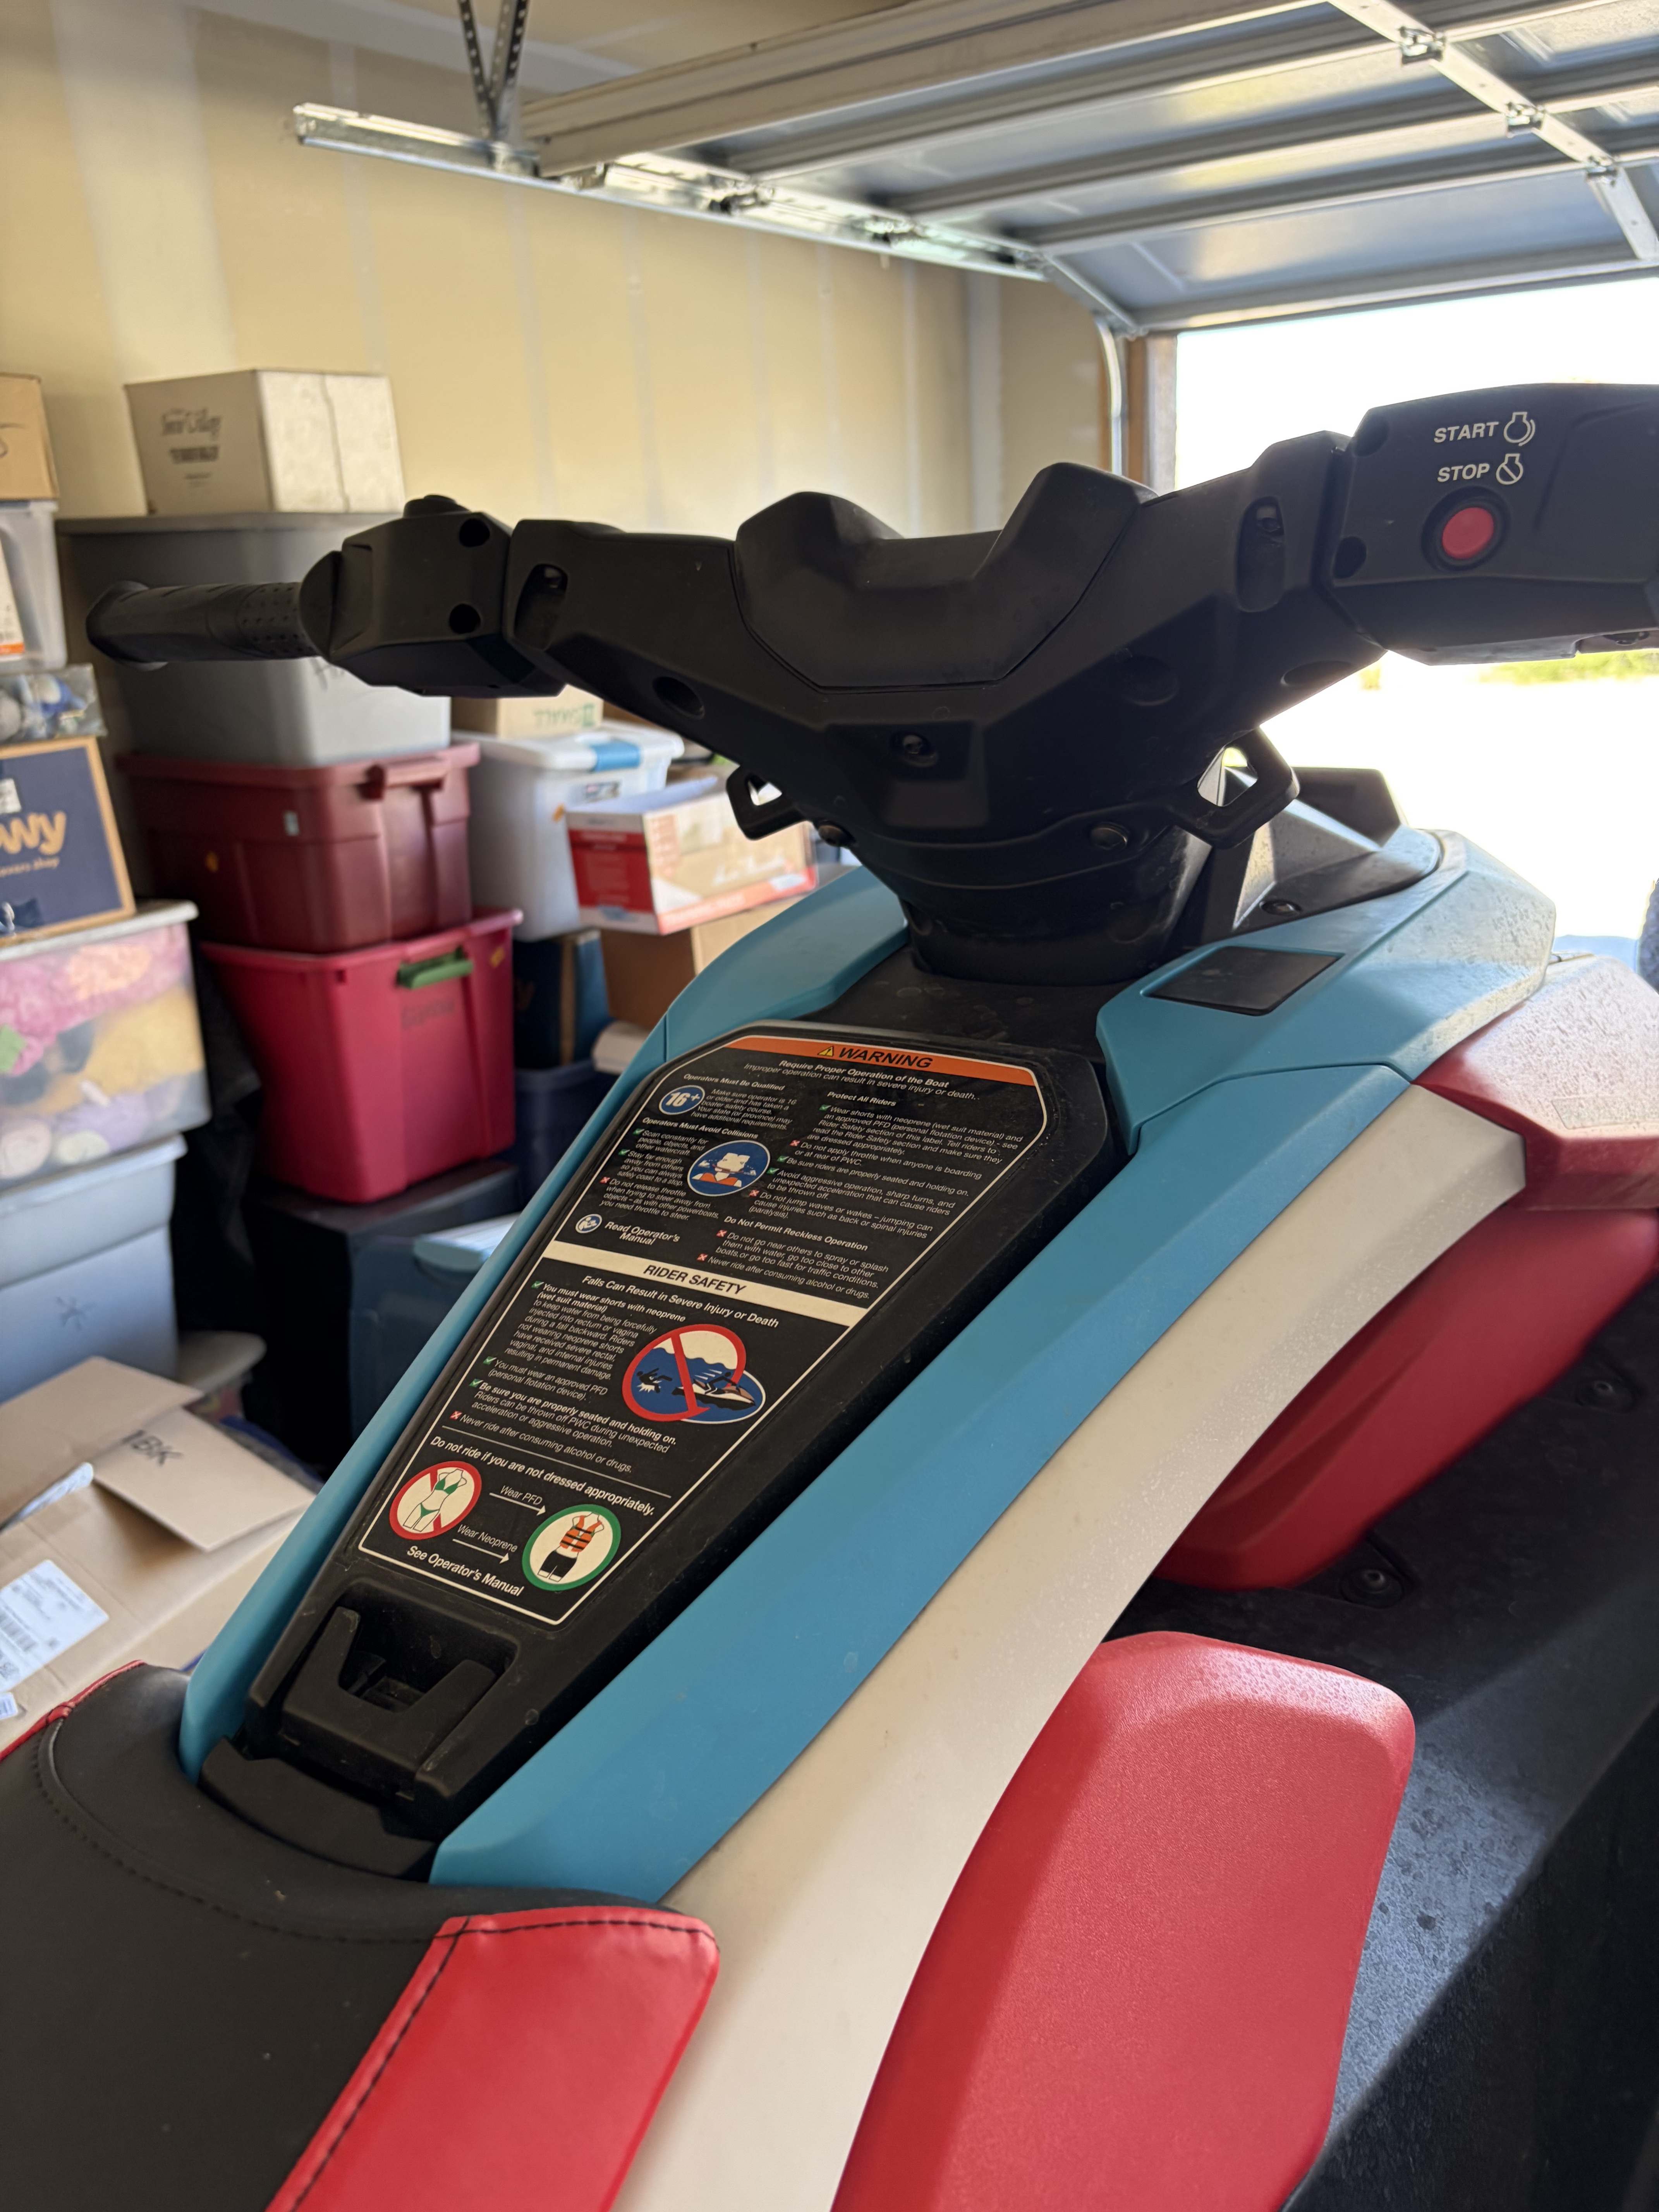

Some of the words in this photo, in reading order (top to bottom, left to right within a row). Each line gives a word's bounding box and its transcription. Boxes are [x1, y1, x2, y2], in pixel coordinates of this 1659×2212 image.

[1434, 421, 1499, 443] START
[1437, 463, 1490, 483] STOP
[838, 1047, 933, 1068] WARNING
[684, 1073, 719, 1082] Operators
[751, 1081, 785, 1090] Qualified
[743, 1063, 782, 1073] Improper
[781, 1069, 822, 1078] operation
[840, 1076, 866, 1084] result
[876, 1081, 907, 1089] severe
[908, 1084, 934, 1094] injury
[778, 1060, 813, 1070] Require
[814, 1064, 847, 1073] Proper
[847, 1068, 893, 1080] Operation
[924, 1079, 949, 1088] Boat
[665, 1092, 700, 1106] 16+
[827, 1091, 857, 1100] Protect
[869, 1097, 896, 1106] Riders
[642, 1117, 678, 1127] Operators
[698, 1125, 721, 1133] Avoid
[721, 1128, 758, 1139] Collisions
[660, 1133, 697, 1144] constantly
[748, 1205, 788, 1219] (paralysis).
[604, 1221, 631, 1232] Read
[630, 1226, 680, 1242] Operator's
[619, 1232, 656, 1245] Manual
[737, 1218, 754, 1227] Not
[754, 1221, 783, 1233] Permit
[783, 1228, 823, 1241] Reckless
[824, 1236, 867, 1251] Operation
[643, 1264, 688, 1282] RIDER
[689, 1274, 747, 1294] SAFETY
[536, 1291, 556, 1301] (wet
[571, 1300, 608, 1313] material)
[543, 1283, 557, 1292] You
[557, 1288, 579, 1297] must
[579, 1293, 600, 1301] wear
[599, 1297, 626, 1307] shorts
[627, 1304, 645, 1312] with
[645, 1308, 685, 1322] neoprene
[582, 1275, 605, 1286] Falls
[605, 1281, 625, 1291] Can
[625, 1285, 658, 1298] Result
[657, 1292, 668, 1301] in
[668, 1295, 703, 1309] Severe
[703, 1303, 733, 1317] Injury
[747, 1313, 779, 1328] Death
[524, 1315, 549, 1327] during
[555, 1322, 569, 1330] fall
[568, 1324, 608, 1340] backward.
[608, 1334, 635, 1346] Riders
[529, 1307, 560, 1319] injected
[558, 1314, 574, 1322] into
[574, 1319, 602, 1329] rectum
[613, 1327, 639, 1338] vagina
[541, 1301, 560, 1311] keep
[561, 1306, 582, 1315] water
[581, 1310, 599, 1319] from
[599, 1314, 622, 1326] being
[622, 1319, 657, 1334] forcefully
[513, 1329, 532, 1340] have
[532, 1336, 567, 1348] received
[565, 1344, 592, 1355] severe
[592, 1350, 616, 1362] rectal,
[532, 1326, 562, 1338] wearing
[562, 1334, 598, 1347] neoprene
[598, 1343, 624, 1353] shorts
[504, 1348, 534, 1360] resulting
[540, 1357, 581, 1371] permanent
[580, 1366, 611, 1380] damage.
[510, 1340, 538, 1352] vaginal,
[538, 1347, 556, 1355] and
[554, 1349, 586, 1362] internal
[584, 1357, 613, 1370] injuries
[488, 1368, 525, 1383] (personal
[524, 1377, 556, 1391] flotation
[556, 1387, 586, 1401] device).
[494, 1359, 509, 1369] You
[508, 1365, 528, 1374] must
[527, 1369, 546, 1378] wear
[555, 1377, 591, 1391] approved
[589, 1384, 608, 1395] PFD
[471, 1401, 519, 1419] acceleration
[528, 1418, 572, 1435] aggressive
[572, 1430, 612, 1447] operation.
[474, 1390, 500, 1403] Riders
[500, 1399, 515, 1408] can
[515, 1402, 527, 1411] be
[527, 1406, 555, 1419] thrown
[555, 1414, 570, 1422] off
[567, 1417, 591, 1429] PWC
[590, 1424, 618, 1439] during
[618, 1433, 670, 1453] unexpected
[479, 1382, 491, 1391] Be
[491, 1387, 510, 1396] sure
[509, 1392, 527, 1401] you
[527, 1396, 542, 1405] are
[540, 1401, 579, 1416] properly
[578, 1411, 610, 1424] seated
[608, 1420, 629, 1429] and
[627, 1423, 662, 1441] holding
[662, 1436, 676, 1445] on.
[459, 1414, 484, 1427] Never
[483, 1422, 500, 1432] ride
[499, 1427, 520, 1437] after
[519, 1433, 563, 1452] consuming
[563, 1446, 596, 1460] alcohol
[606, 1458, 631, 1473] drugs.
[430, 1436, 445, 1447] Do
[444, 1442, 463, 1453] not
[461, 1447, 481, 1458] ride
[480, 1451, 492, 1461] if
[487, 1455, 508, 1467] you
[507, 1462, 525, 1472] are
[525, 1467, 544, 1478] not
[543, 1472, 586, 1491] dressed
[584, 1486, 654, 1516] appropriately.
[500, 1485, 523, 1499] Wear
[522, 1492, 542, 1505] PFD
[457, 1524, 479, 1538] Wear
[477, 1532, 517, 1552] Neoprene
[407, 1545, 427, 1560] See
[428, 1553, 482, 1580] Operator's
[481, 1573, 524, 1596] Manual
